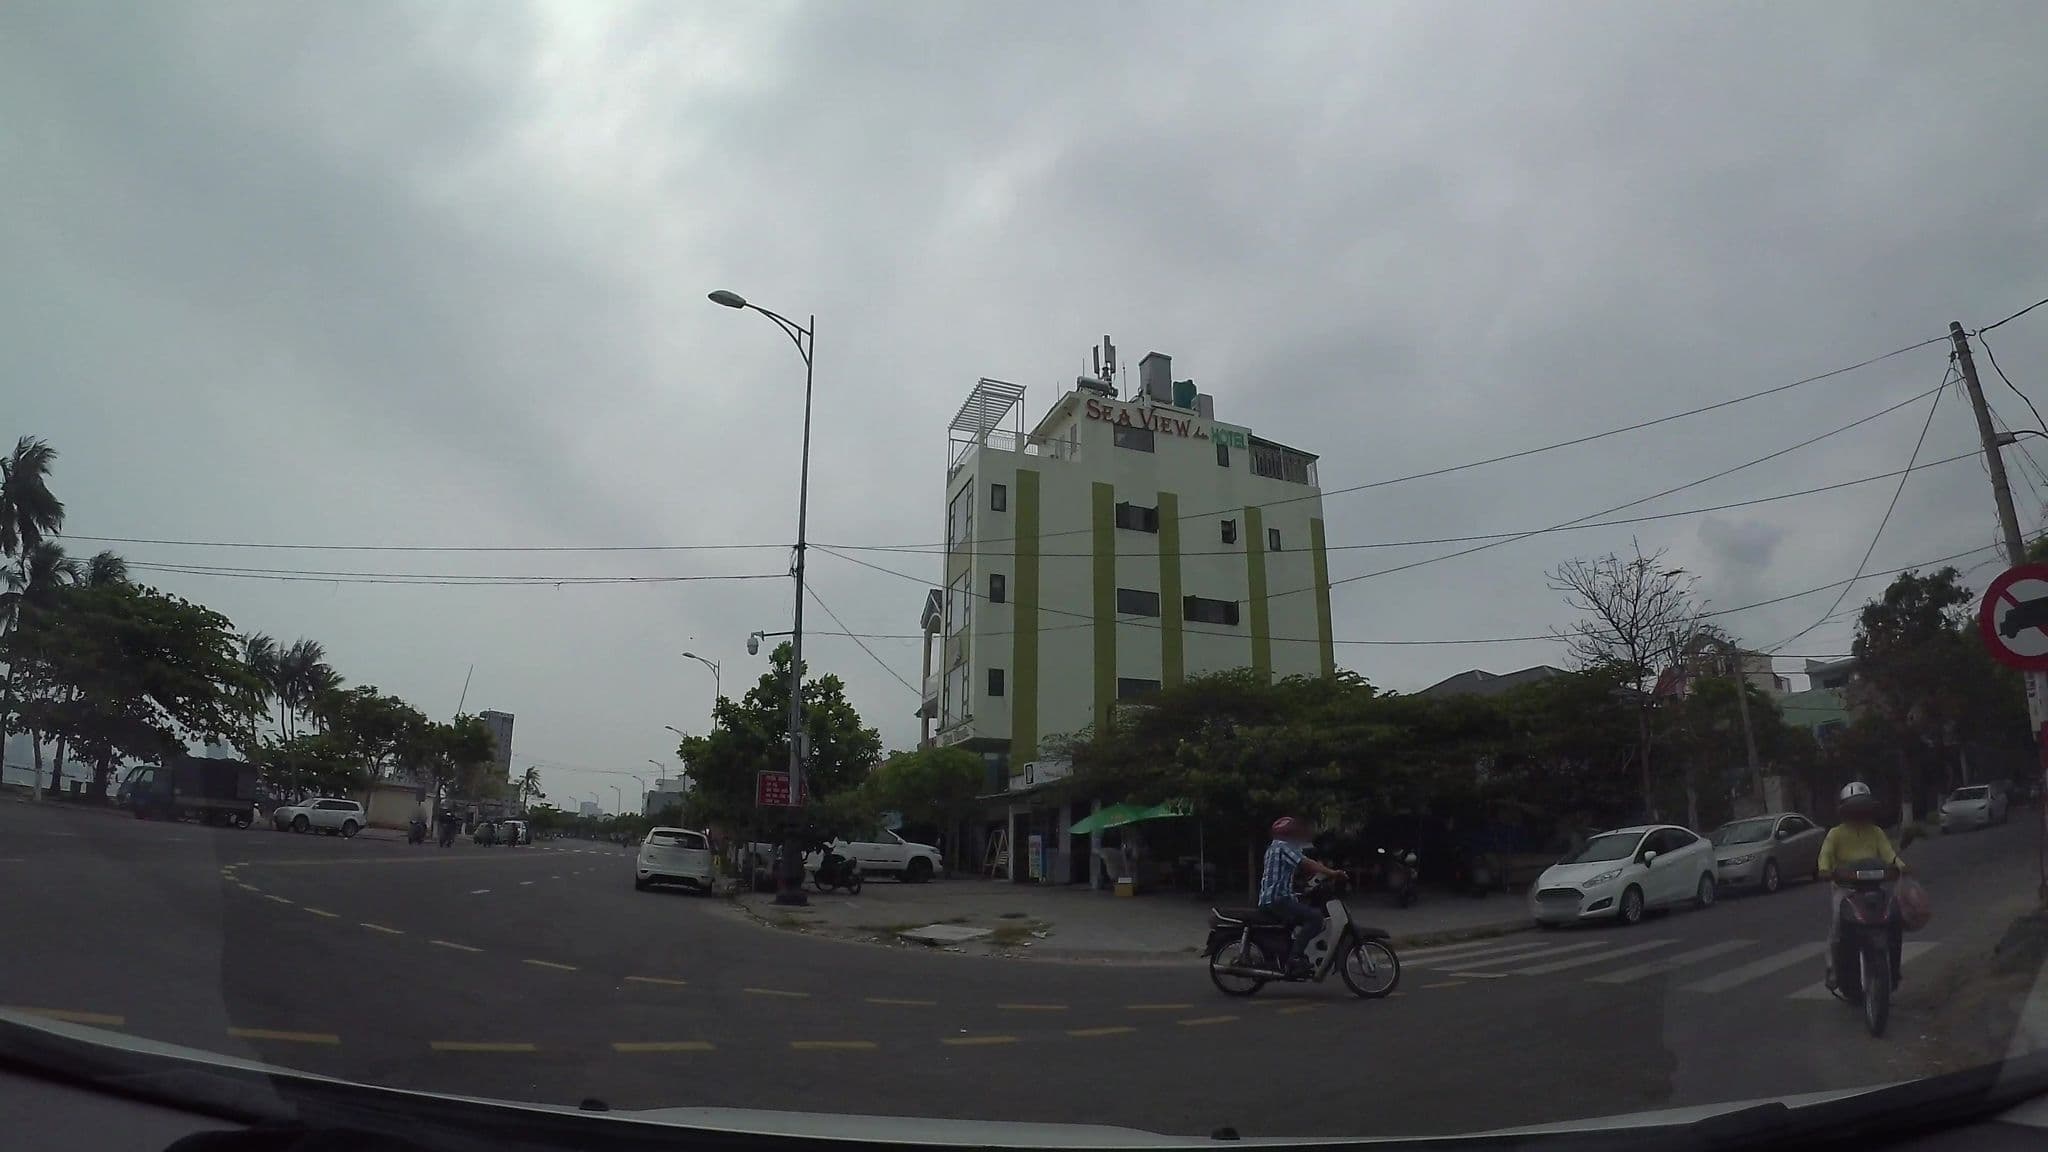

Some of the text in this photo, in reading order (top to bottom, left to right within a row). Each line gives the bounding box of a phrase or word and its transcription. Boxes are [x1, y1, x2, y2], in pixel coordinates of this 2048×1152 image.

[1087, 399, 1131, 426] SEA
[1138, 408, 1191, 437] VIEW
[1211, 427, 1247, 449] HOTEL
